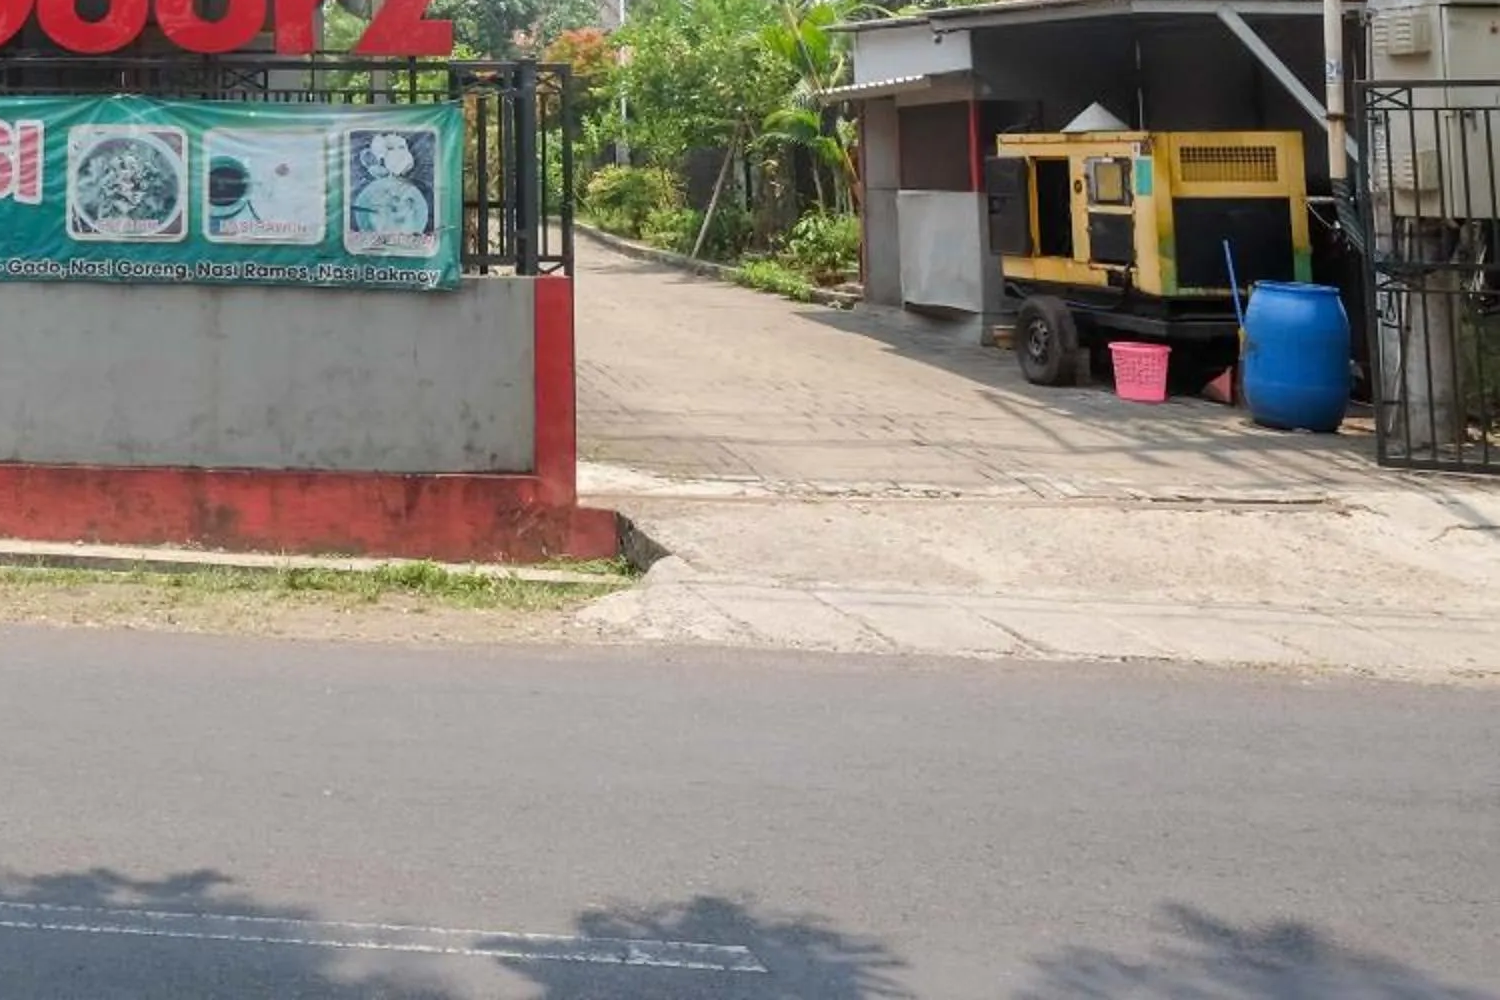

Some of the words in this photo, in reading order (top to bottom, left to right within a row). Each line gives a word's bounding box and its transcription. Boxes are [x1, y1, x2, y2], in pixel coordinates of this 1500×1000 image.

[6, 258, 67, 279] Gado,
[70, 258, 112, 275] Nasi
[116, 259, 194, 281] Goreng,
[196, 260, 238, 278] Nasi
[243, 262, 314, 281] Rames,
[318, 264, 358, 281] Nasi
